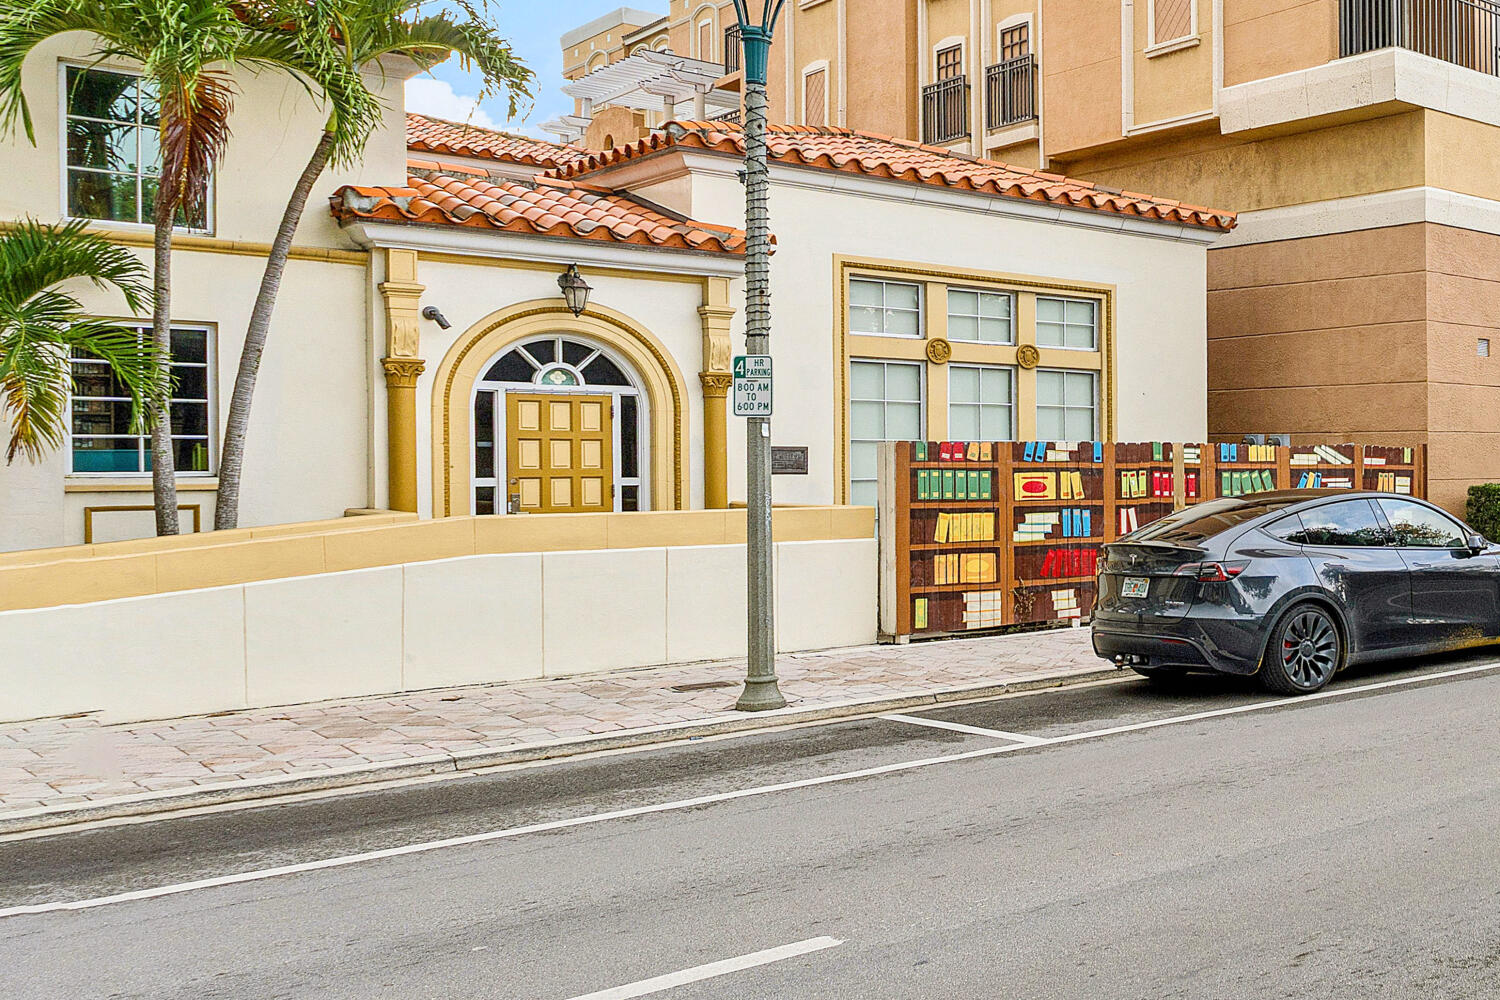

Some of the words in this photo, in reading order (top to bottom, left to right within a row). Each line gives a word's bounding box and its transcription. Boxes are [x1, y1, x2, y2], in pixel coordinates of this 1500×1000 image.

[735, 360, 744, 376] 4
[754, 359, 764, 367] HR
[746, 368, 771, 376] PARKING
[757, 383, 769, 391] AM
[746, 393, 757, 401] TO
[757, 402, 769, 411] PM
